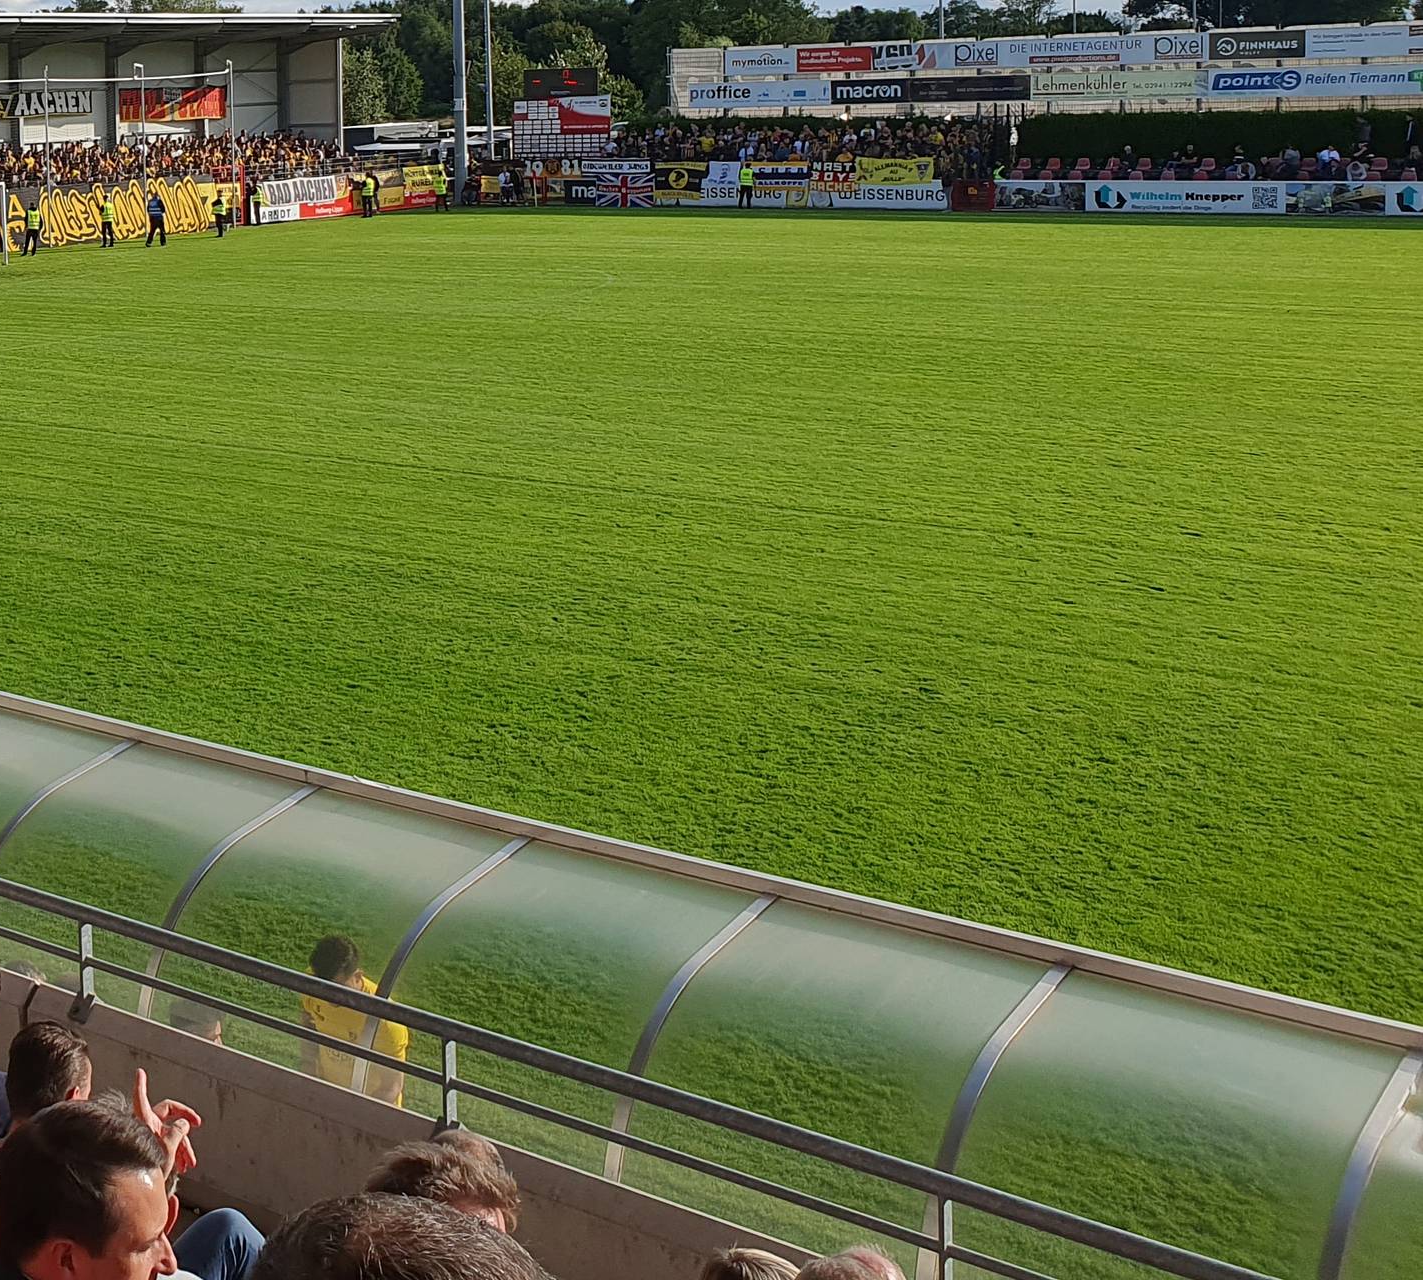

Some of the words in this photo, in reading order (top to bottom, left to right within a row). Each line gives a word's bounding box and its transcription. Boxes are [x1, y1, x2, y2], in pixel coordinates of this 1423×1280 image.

[1009, 43, 1027, 54] DIE
[1030, 40, 1142, 52] INTERNETAGENTUR
[1239, 40, 1298, 50] FINNHAUS
[1033, 75, 1127, 91] Lehmenkühler
[1218, 75, 1272, 88] point
[1305, 73, 1346, 84] Reifen
[1349, 72, 1406, 84] Tiemann
[690, 85, 751, 102] proffice
[837, 85, 901, 98] macron
[15, 91, 90, 116] AACHEN
[524, 160, 543, 176] 19
[561, 160, 580, 175] 81
[813, 161, 856, 171] NAST
[810, 171, 856, 181] BOYS
[268, 182, 292, 205] BAD
[293, 178, 335, 202] AACHEN
[701, 187, 782, 199] EISSEURG
[1129, 192, 1182, 201] Wilhelm
[1185, 192, 1244, 202] Knepper
